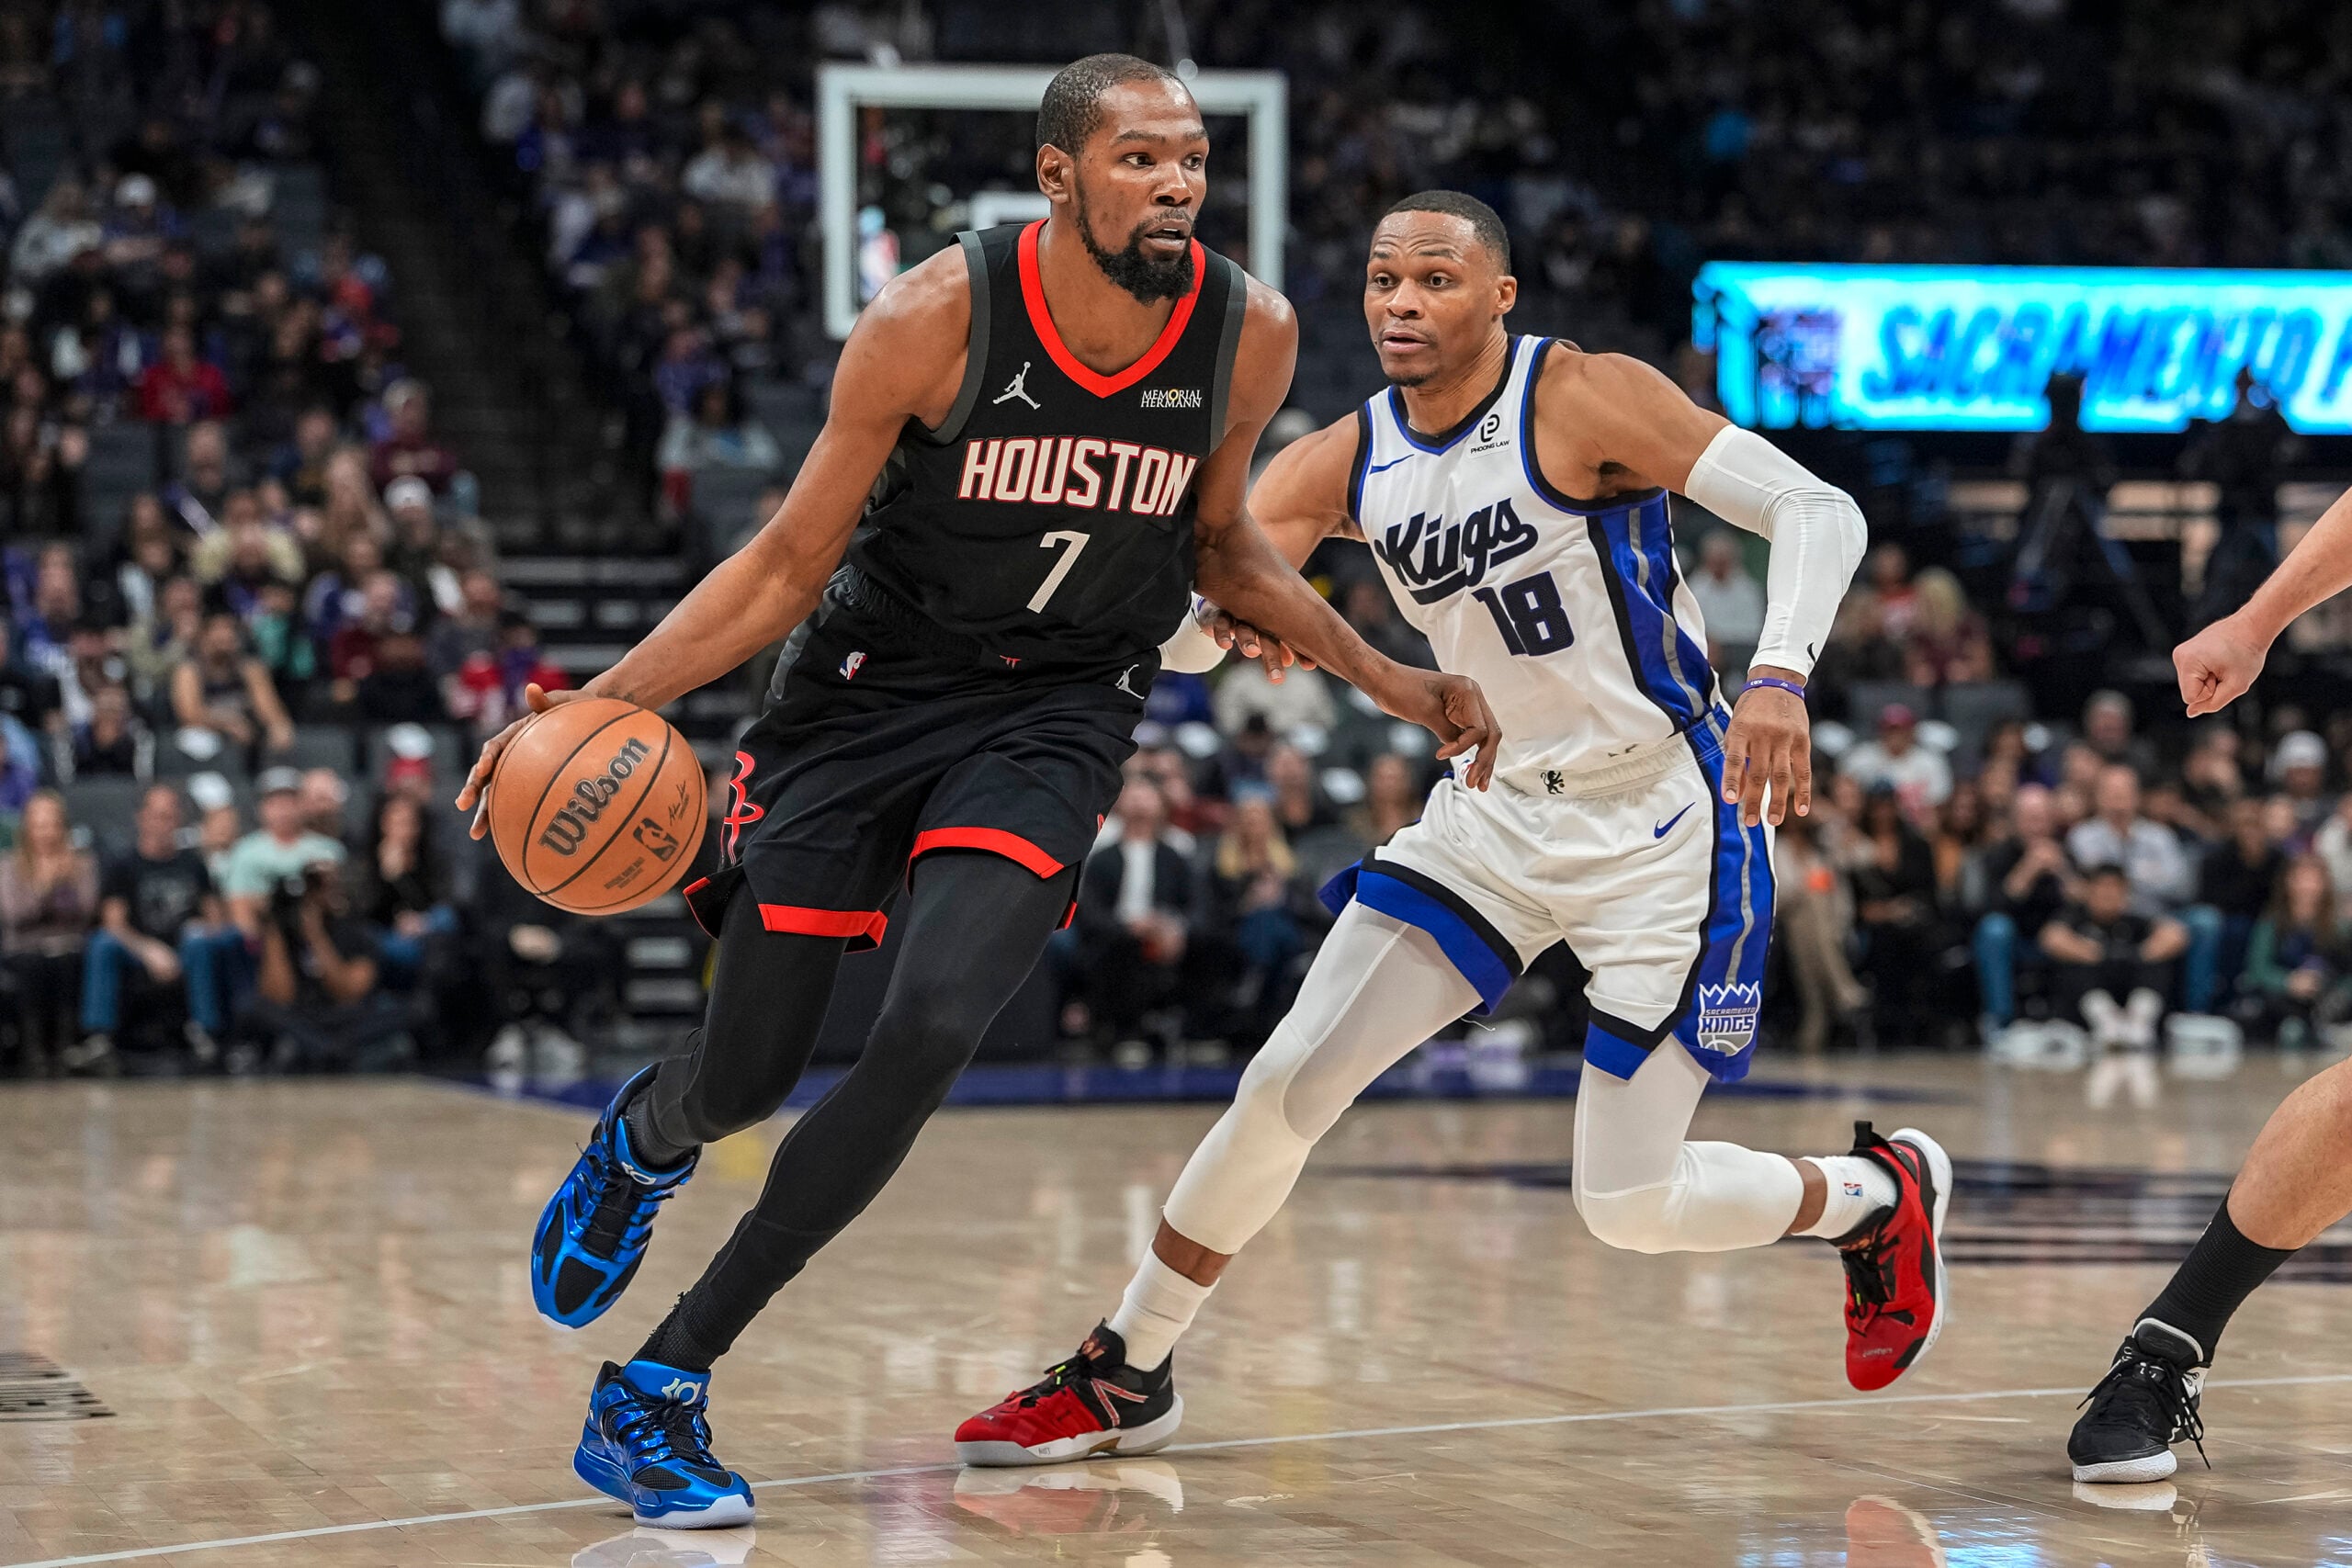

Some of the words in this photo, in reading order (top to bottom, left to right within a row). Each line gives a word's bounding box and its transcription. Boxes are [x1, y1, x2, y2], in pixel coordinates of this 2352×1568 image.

[1140, 397, 1203, 408] HERMANN
[1142, 389, 1203, 400] MEMORIAL
[1470, 443, 1496, 454] PHOONG
[1496, 439, 1510, 447] LAW
[957, 436, 1198, 516] HOUSTON
[1026, 530, 1091, 614] 7
[1374, 497, 1539, 605] Kings
[1470, 570, 1575, 657] 18
[538, 738, 651, 858] Wilson
[1701, 1015, 1755, 1033] KINGS
[1704, 1007, 1757, 1016] SACRAMENTO
